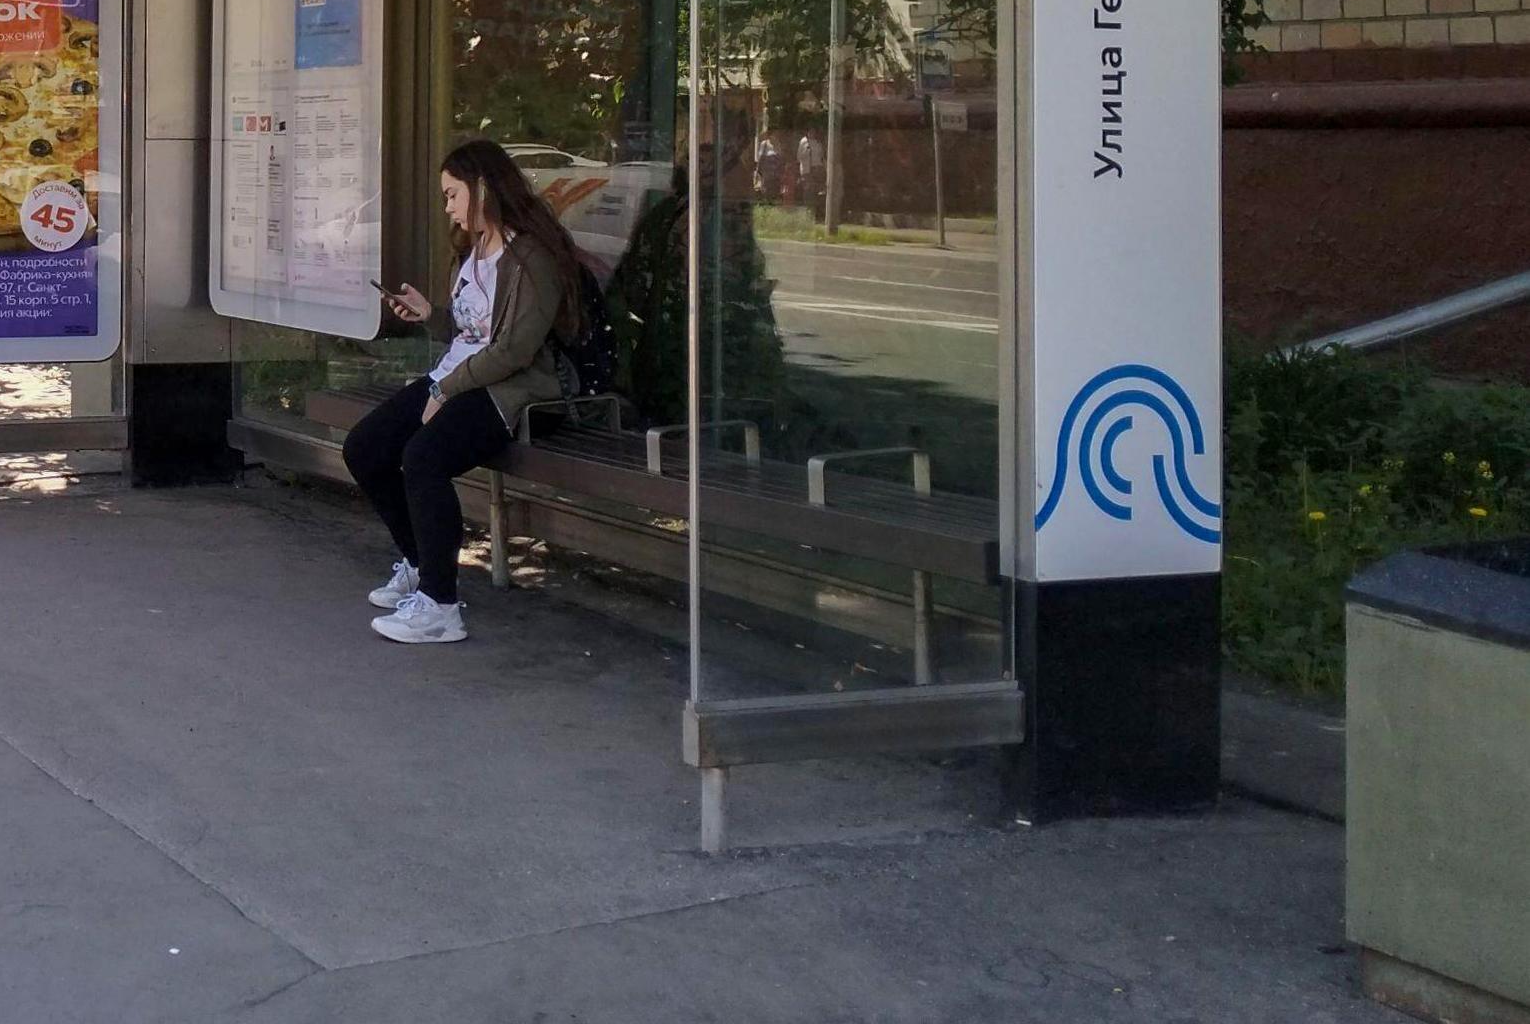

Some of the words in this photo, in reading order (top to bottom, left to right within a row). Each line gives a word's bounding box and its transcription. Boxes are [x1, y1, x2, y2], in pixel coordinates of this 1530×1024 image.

[1093, 40, 1127, 179] Улица
[32, 184, 77, 201] Доставим
[30, 204, 76, 233] 45
[34, 235, 62, 250] минут
[12, 257, 87, 269] подробности
[17, 284, 26, 293] г.
[28, 282, 68, 293] Санкт-
[5, 295, 16, 306] 15
[18, 297, 48, 307] корп.
[51, 294, 59, 305] 5
[60, 295, 83, 307] стр.
[16, 309, 53, 320] акции:
